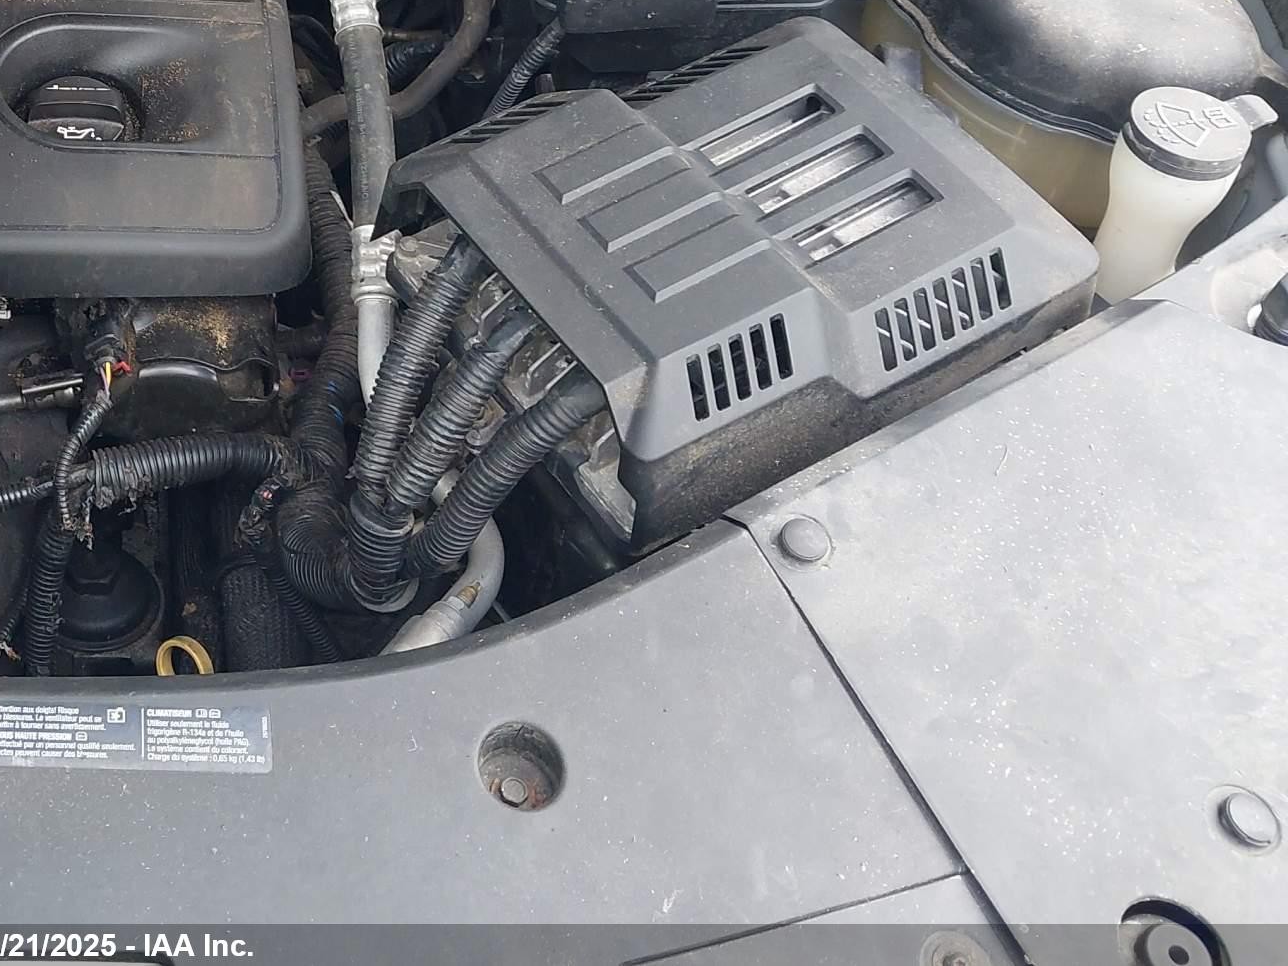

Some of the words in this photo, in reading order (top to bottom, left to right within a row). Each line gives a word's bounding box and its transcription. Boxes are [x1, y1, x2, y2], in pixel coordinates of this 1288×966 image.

[35, 706, 56, 714] doigts!
[58, 706, 79, 715] Risque
[147, 709, 192, 718] CLIMATISEUR
[79, 715, 93, 723] peut
[170, 720, 203, 728] seulement
[15, 732, 37, 740] HAUTE
[38, 732, 72, 740] PRESSION
[148, 728, 181, 736] frigorigène
[148, 744, 155, 752] Le
[157, 745, 183, 753] système
[184, 745, 210, 753] contient
[211, 746, 220, 754] du
[221, 746, 248, 754] colorant.
